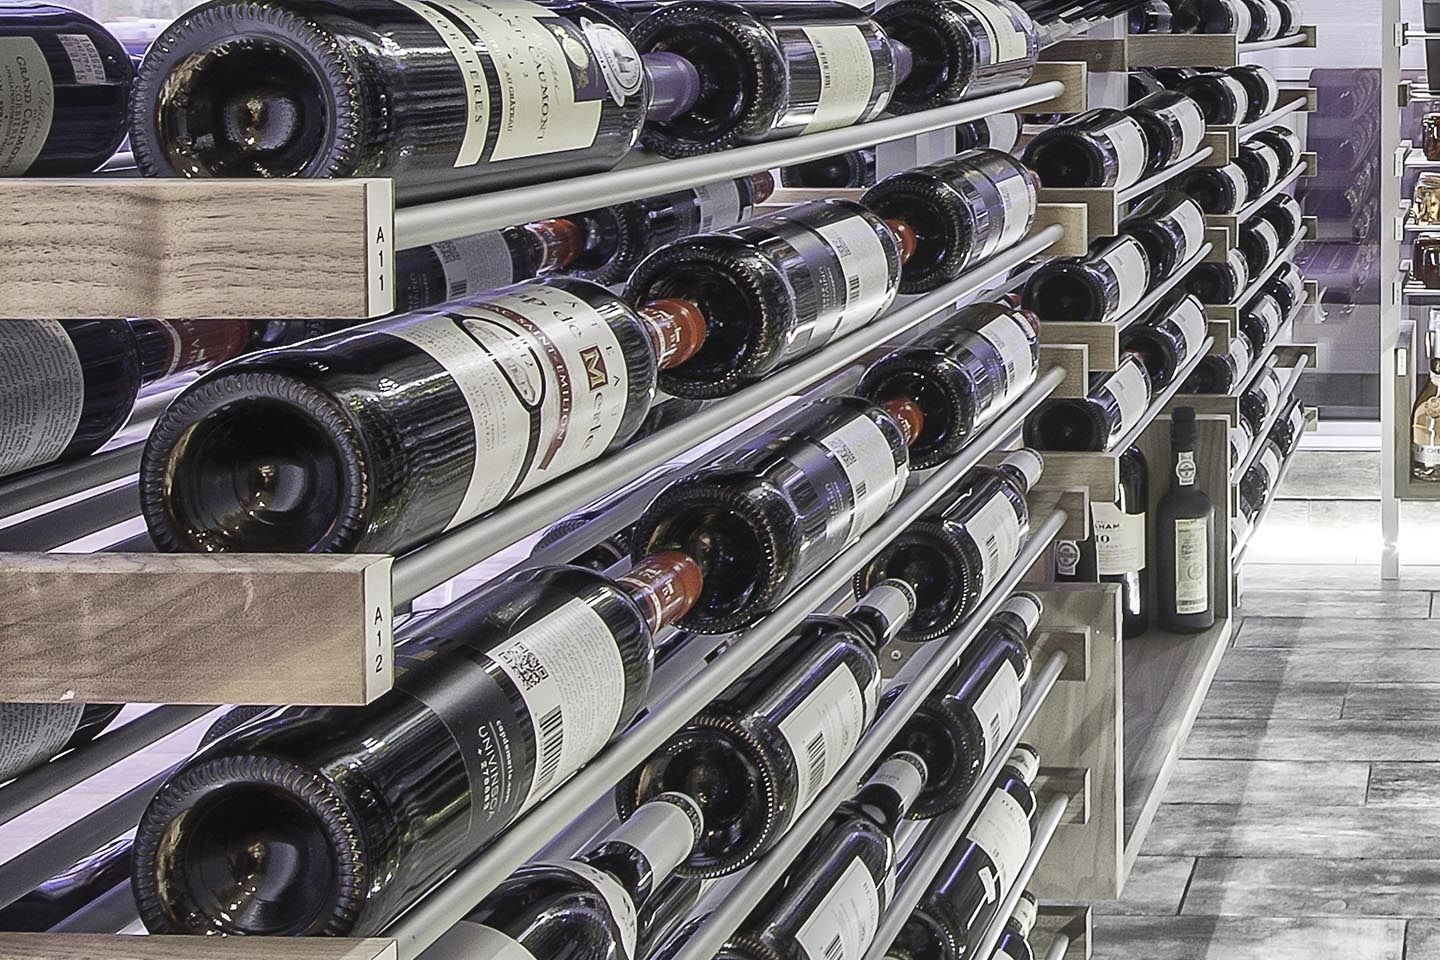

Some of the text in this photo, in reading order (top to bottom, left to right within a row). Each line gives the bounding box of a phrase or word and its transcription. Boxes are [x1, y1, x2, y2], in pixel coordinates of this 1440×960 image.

[16, 55, 32, 104] GRAND
[529, 45, 549, 141] CAUMONT
[375, 225, 385, 293] A11
[553, 310, 582, 338] de
[374, 606, 383, 674] A12
